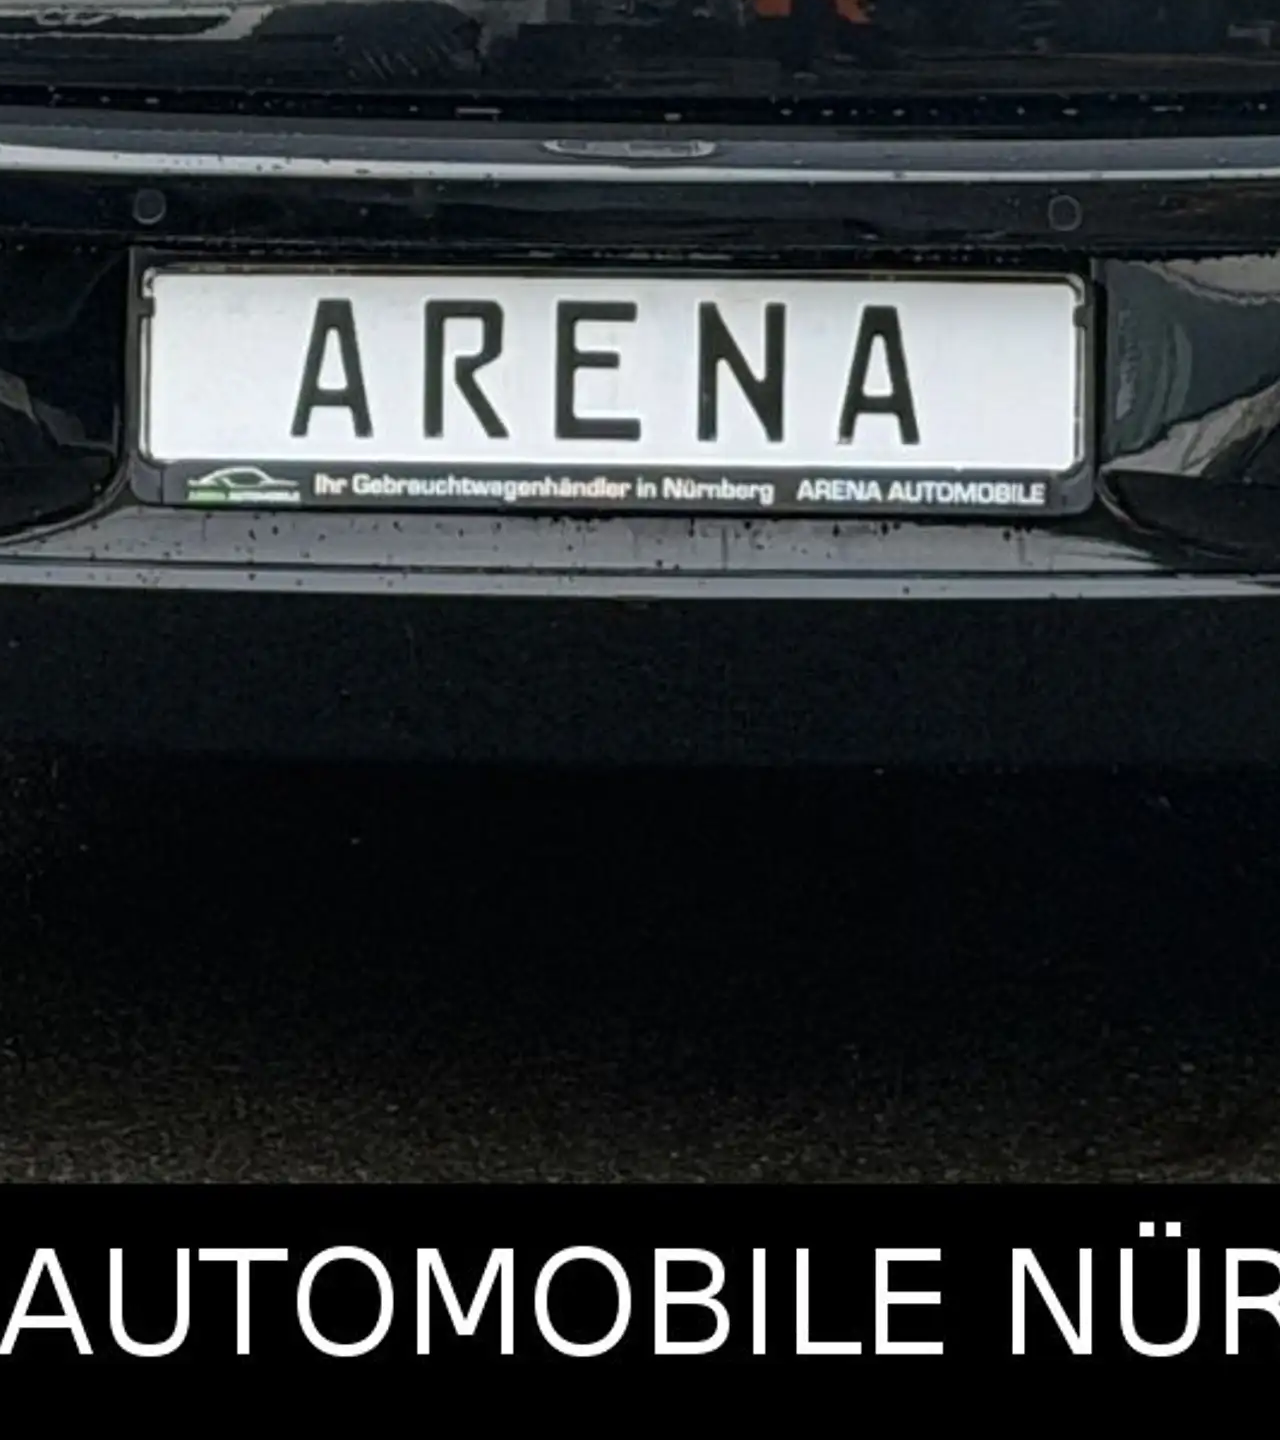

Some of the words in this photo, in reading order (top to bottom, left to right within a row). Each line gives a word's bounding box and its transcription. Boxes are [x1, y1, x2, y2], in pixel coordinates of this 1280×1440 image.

[292, 299, 919, 445] ARENA
[314, 472, 349, 496] Ihr
[352, 472, 631, 504] Gebrauchtwagenhändler
[636, 476, 657, 499] in
[661, 476, 775, 507] Nürnberg
[796, 480, 882, 503] ARENA
[887, 480, 1046, 505] AUTOMOBILE
